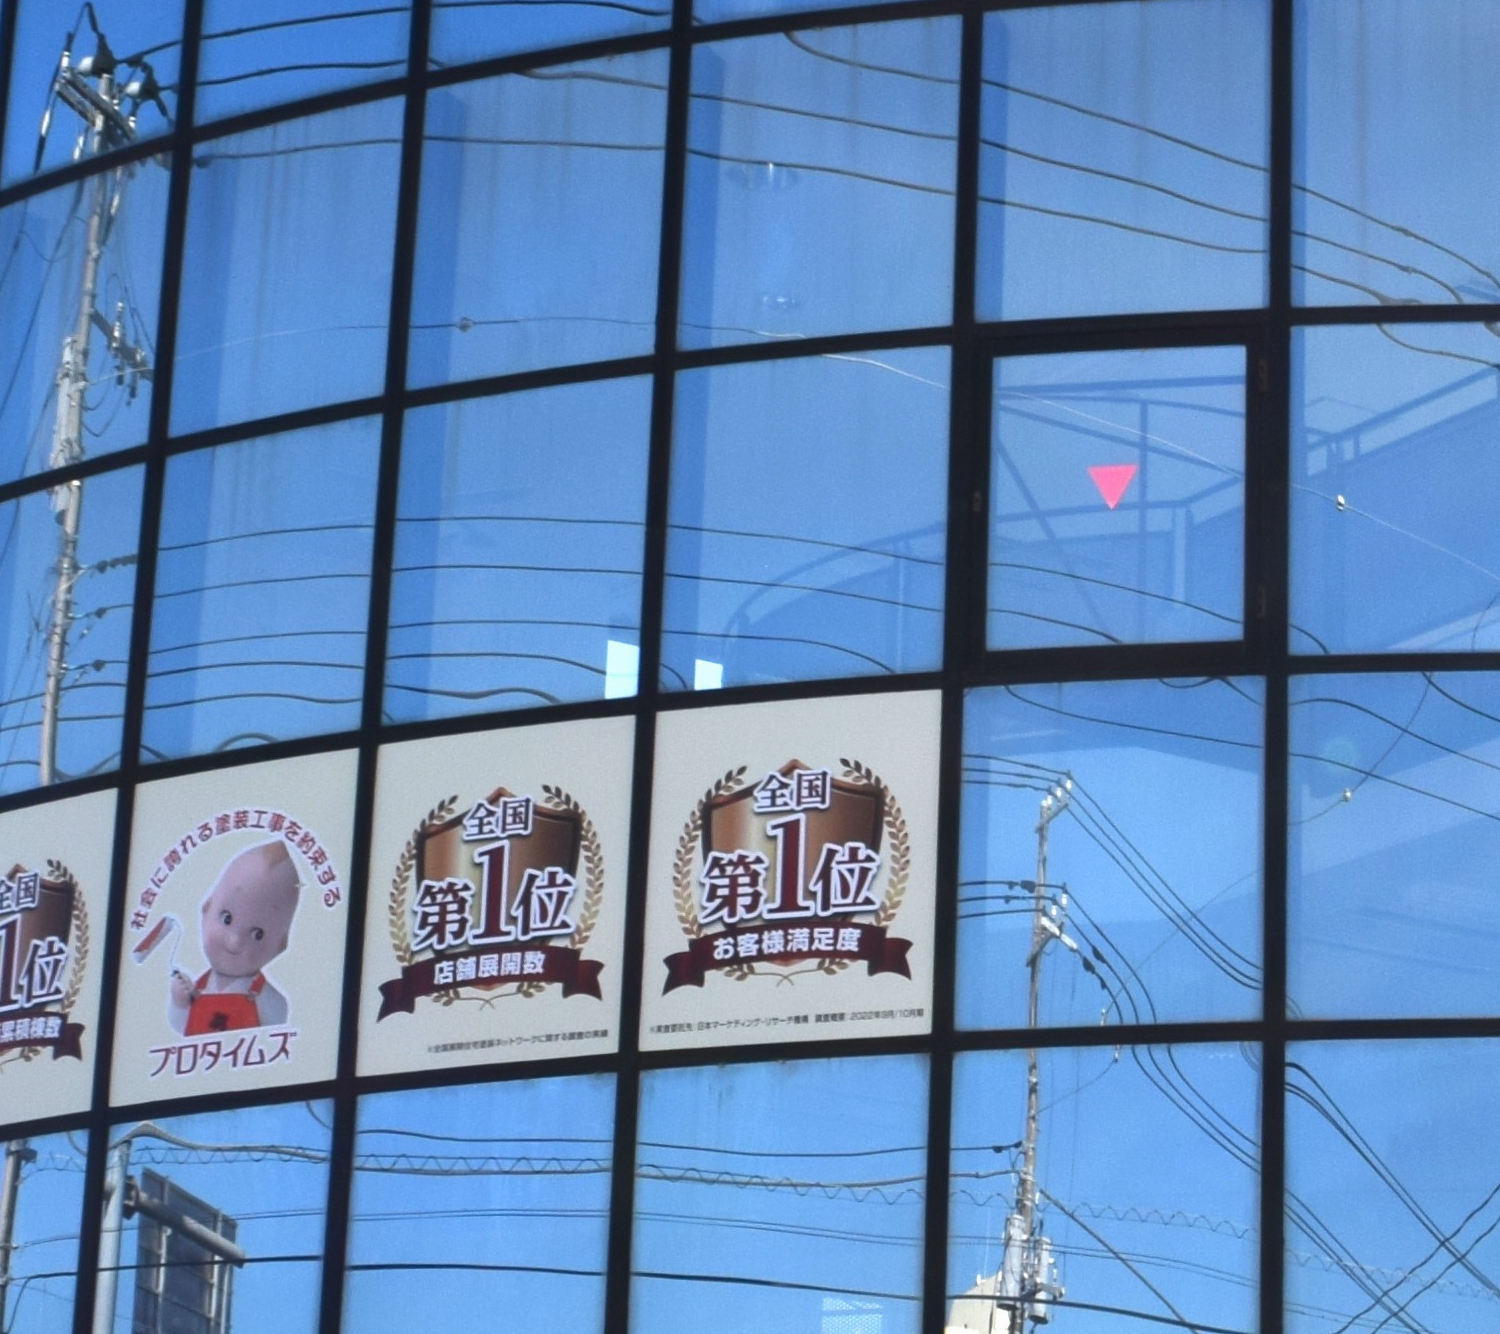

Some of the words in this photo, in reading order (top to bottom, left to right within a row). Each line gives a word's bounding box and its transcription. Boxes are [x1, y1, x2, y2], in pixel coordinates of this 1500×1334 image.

[754, 770, 831, 813] 全国
[464, 797, 532, 841] 全国
[131, 808, 341, 932] 社会に誇れる塗装工事を約束する
[700, 814, 881, 925] 第1位
[412, 838, 576, 951] 第1位
[713, 926, 862, 961] お客様満足度
[433, 951, 545, 985] 店舗展開数
[148, 1030, 297, 1078] プロタイムズ
